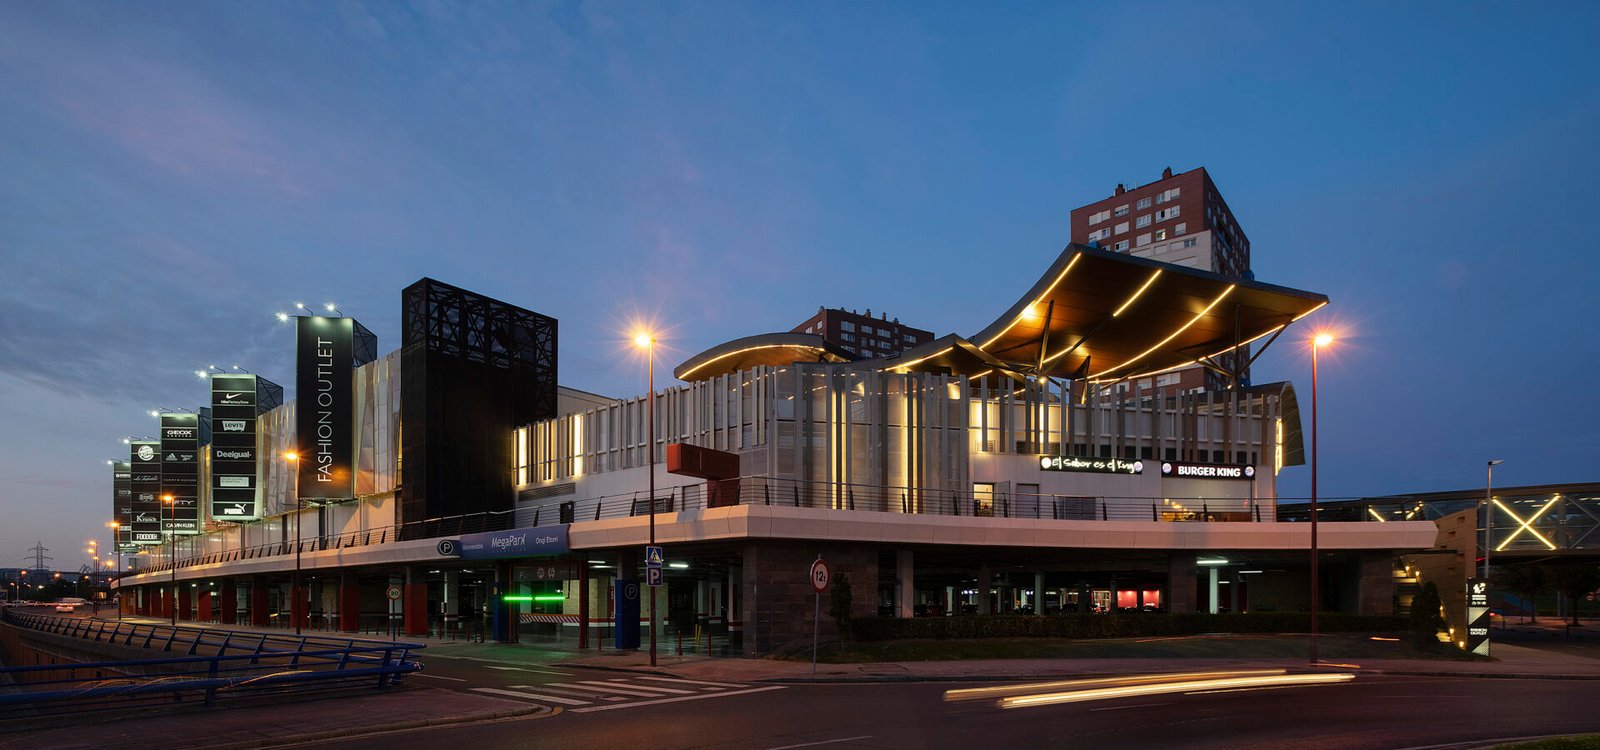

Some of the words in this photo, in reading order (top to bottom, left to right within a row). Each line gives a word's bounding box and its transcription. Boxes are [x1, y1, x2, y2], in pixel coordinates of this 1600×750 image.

[318, 337, 333, 407] OUTLET
[318, 411, 333, 482] FASHION
[1063, 458, 1092, 468] Sabor
[1178, 466, 1216, 476] BURGER
[1216, 468, 1240, 477] KING
[444, 544, 450, 552] P
[650, 569, 659, 584] P
